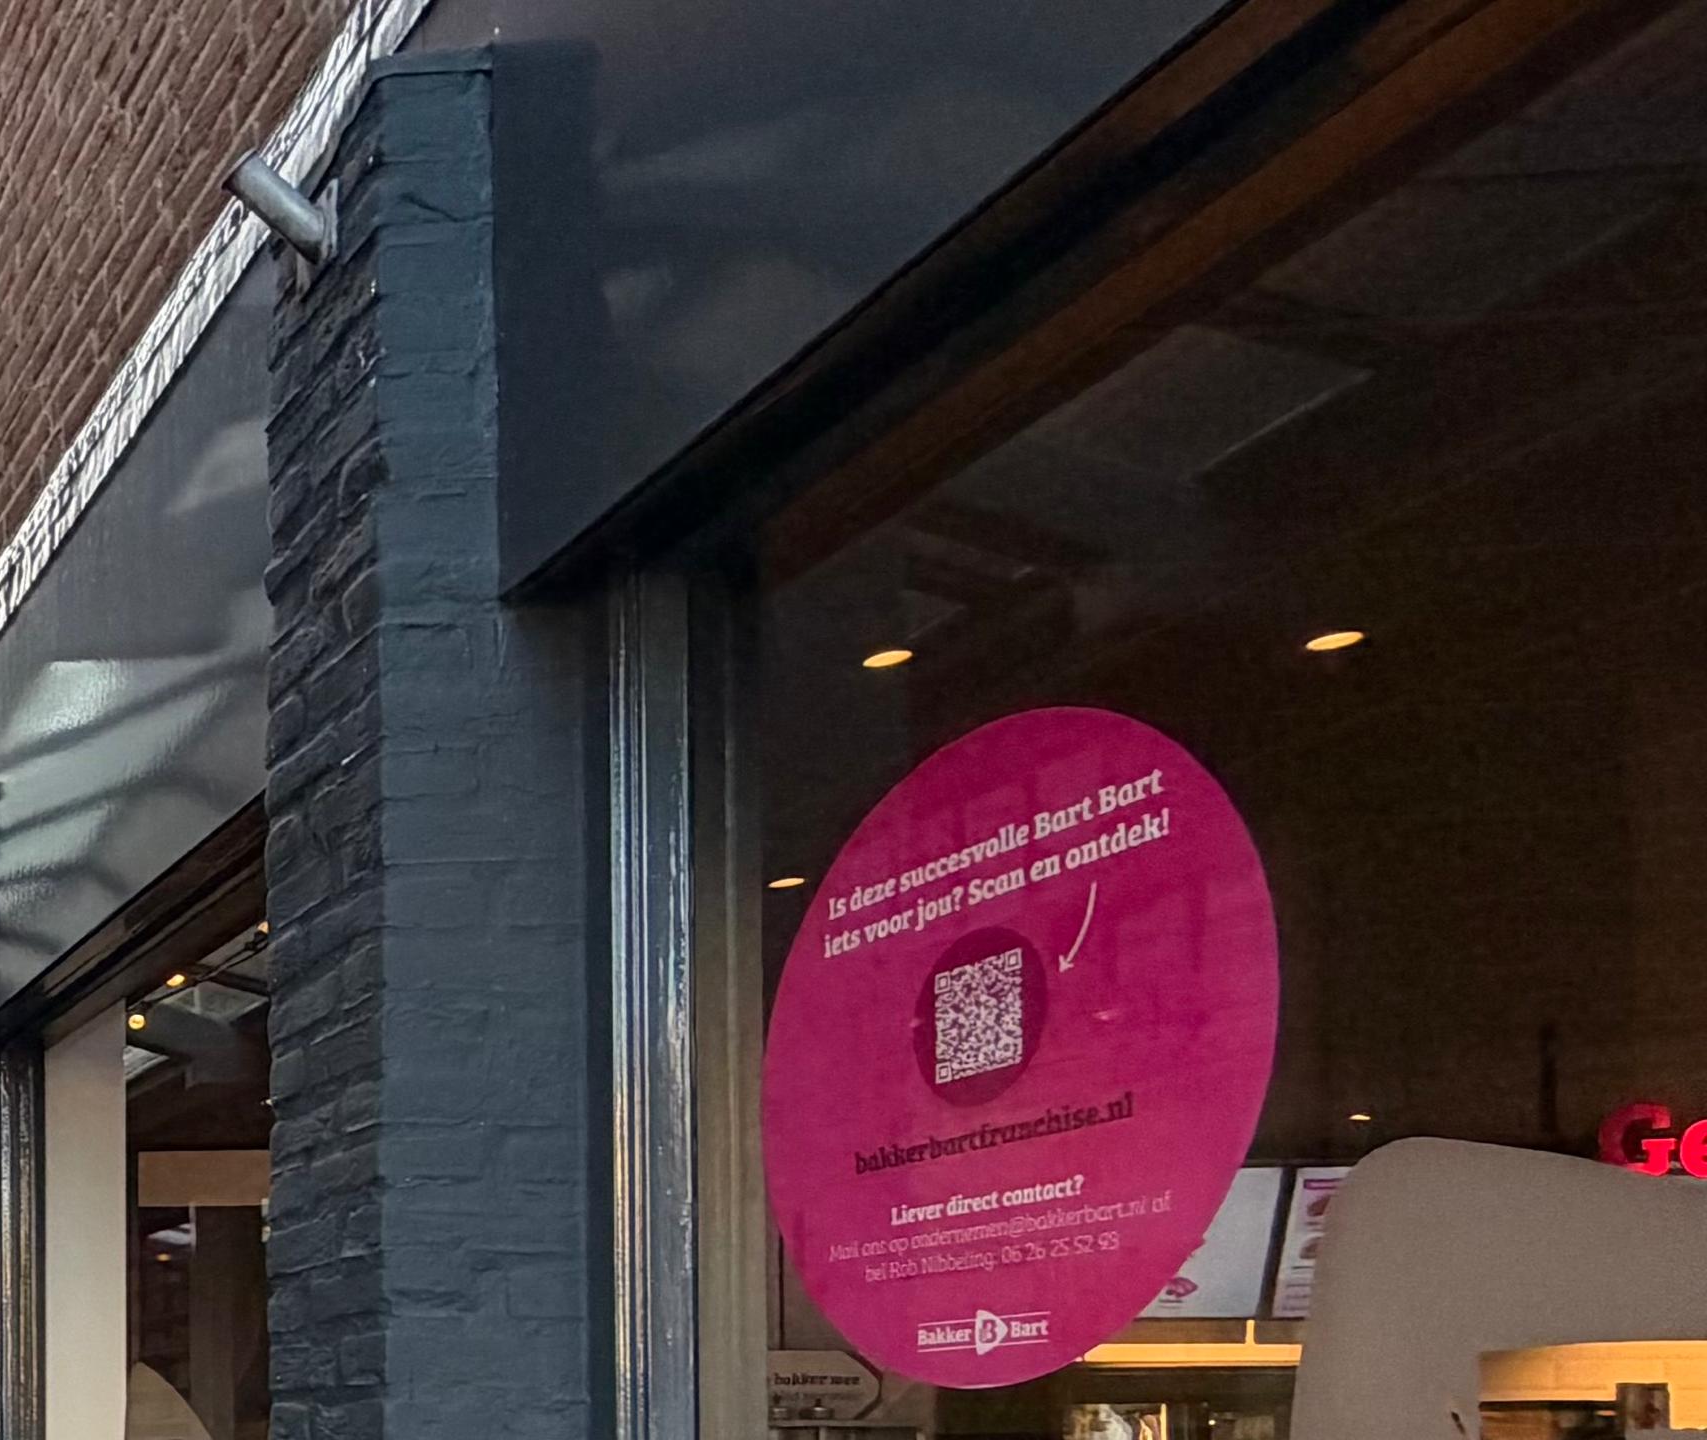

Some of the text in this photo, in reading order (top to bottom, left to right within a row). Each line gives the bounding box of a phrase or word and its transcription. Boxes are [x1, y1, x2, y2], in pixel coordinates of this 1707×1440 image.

[827, 768, 1164, 921] Is deze succesvolle Bart Bart
[824, 808, 1171, 958] iets voor jou? Scan en ontdek!
[854, 1091, 1135, 1175] bakkerbartfranchise.nl
[890, 1174, 1085, 1226] Liever direct contact?
[828, 1240, 860, 1263] Mail
[861, 1240, 887, 1257] ons
[864, 1262, 886, 1283] bel
[889, 1258, 919, 1279] Rob
[916, 1325, 973, 1347] Bakker
[1009, 1319, 1050, 1339] Bart
